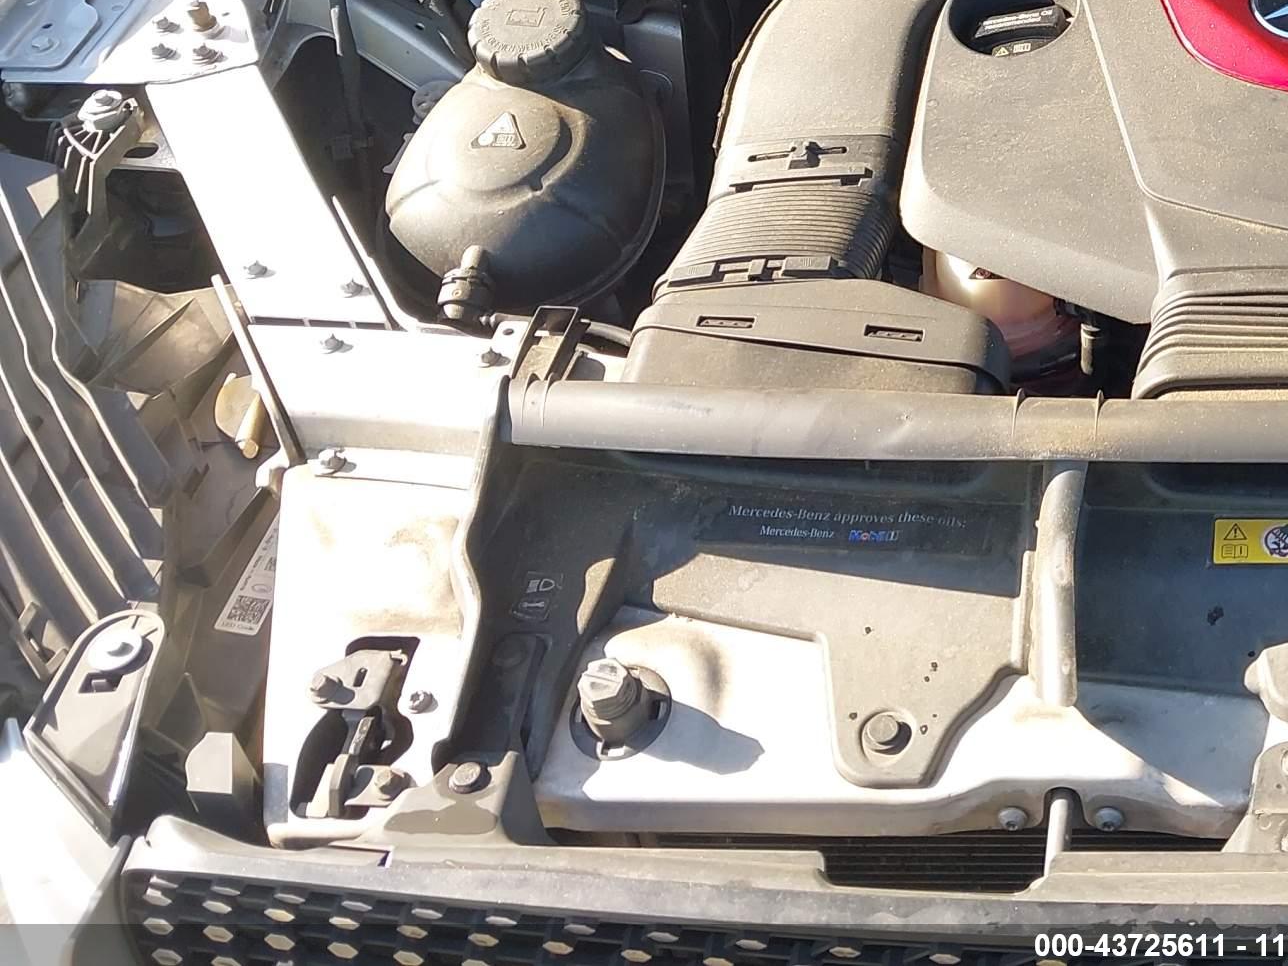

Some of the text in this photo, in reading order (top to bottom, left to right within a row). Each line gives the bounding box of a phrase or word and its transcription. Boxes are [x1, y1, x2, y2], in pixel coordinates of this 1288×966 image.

[729, 505, 831, 522] Mercedes-Benz
[833, 513, 894, 525] approves
[897, 511, 935, 523] these
[760, 525, 835, 539] Mercedes-Benz
